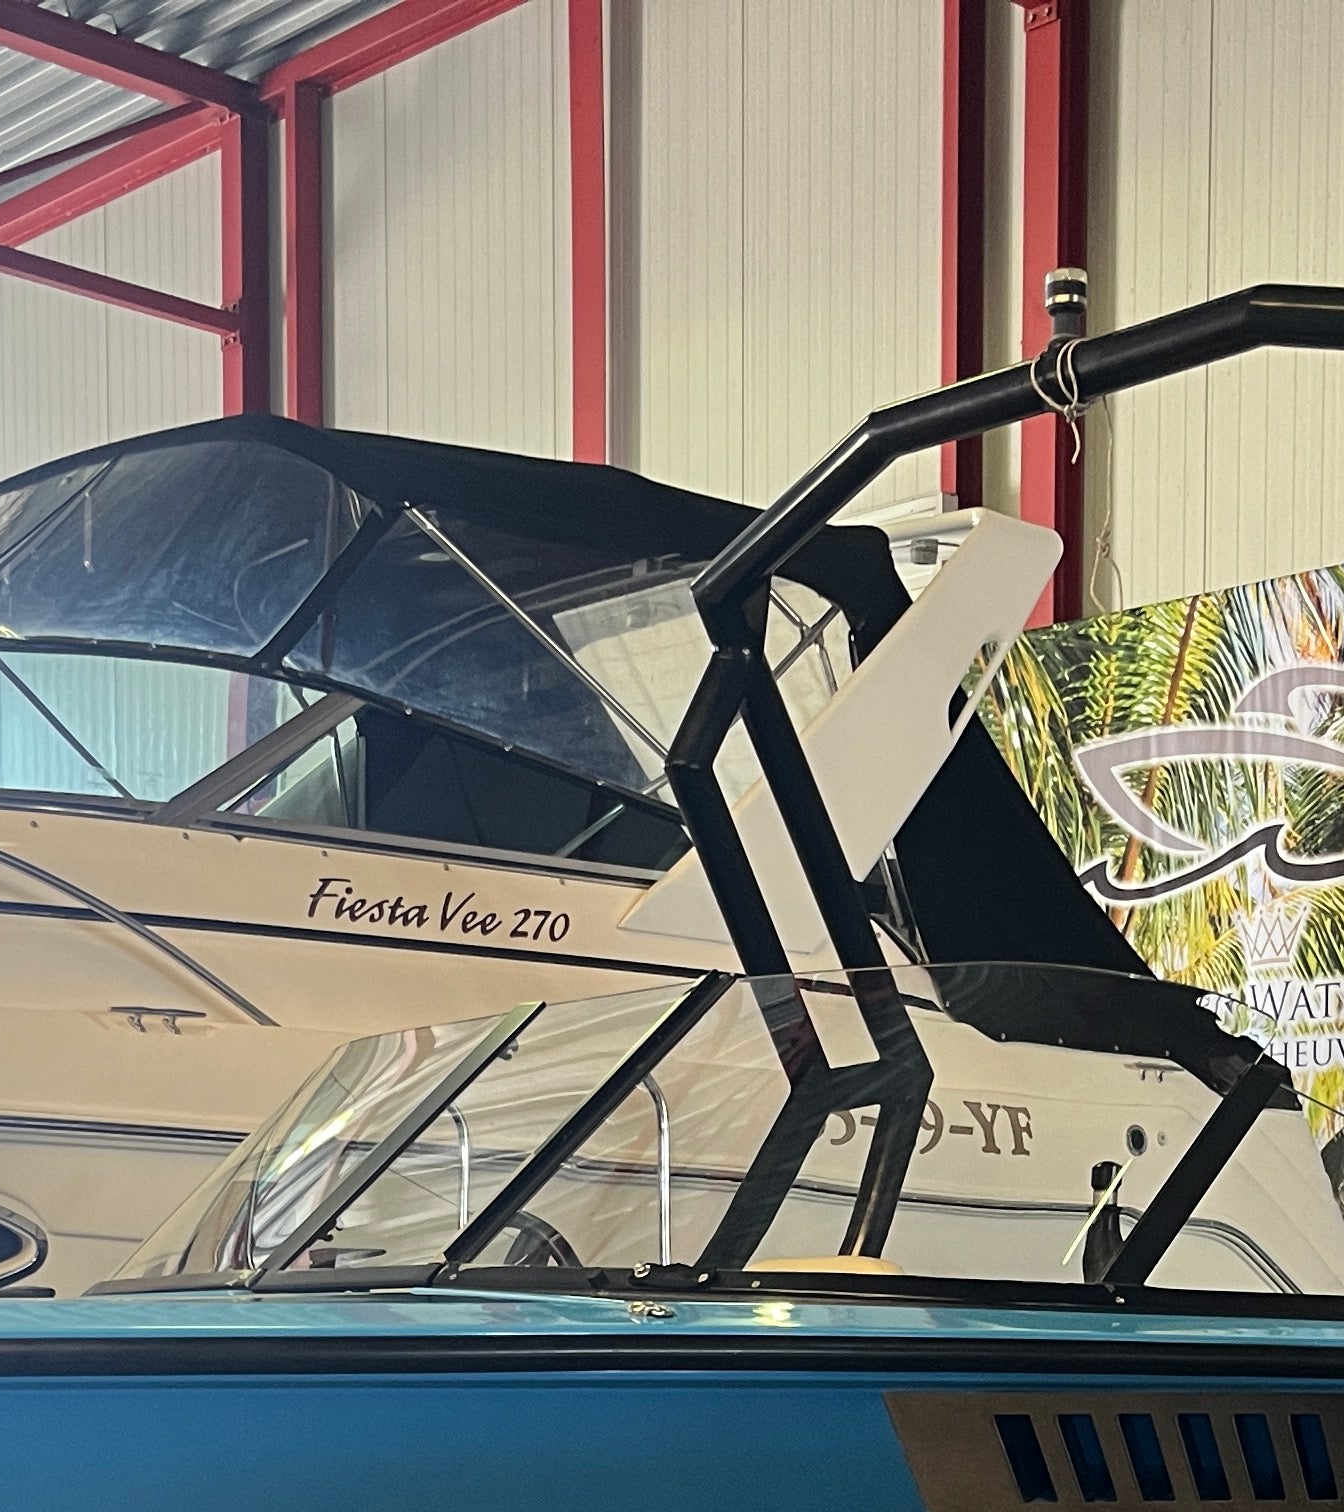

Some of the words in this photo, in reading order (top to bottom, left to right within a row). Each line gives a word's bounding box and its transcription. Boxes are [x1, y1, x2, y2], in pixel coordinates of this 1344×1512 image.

[307, 877, 429, 930] Fiesta
[440, 891, 502, 936] Vee
[509, 908, 570, 942] 270
